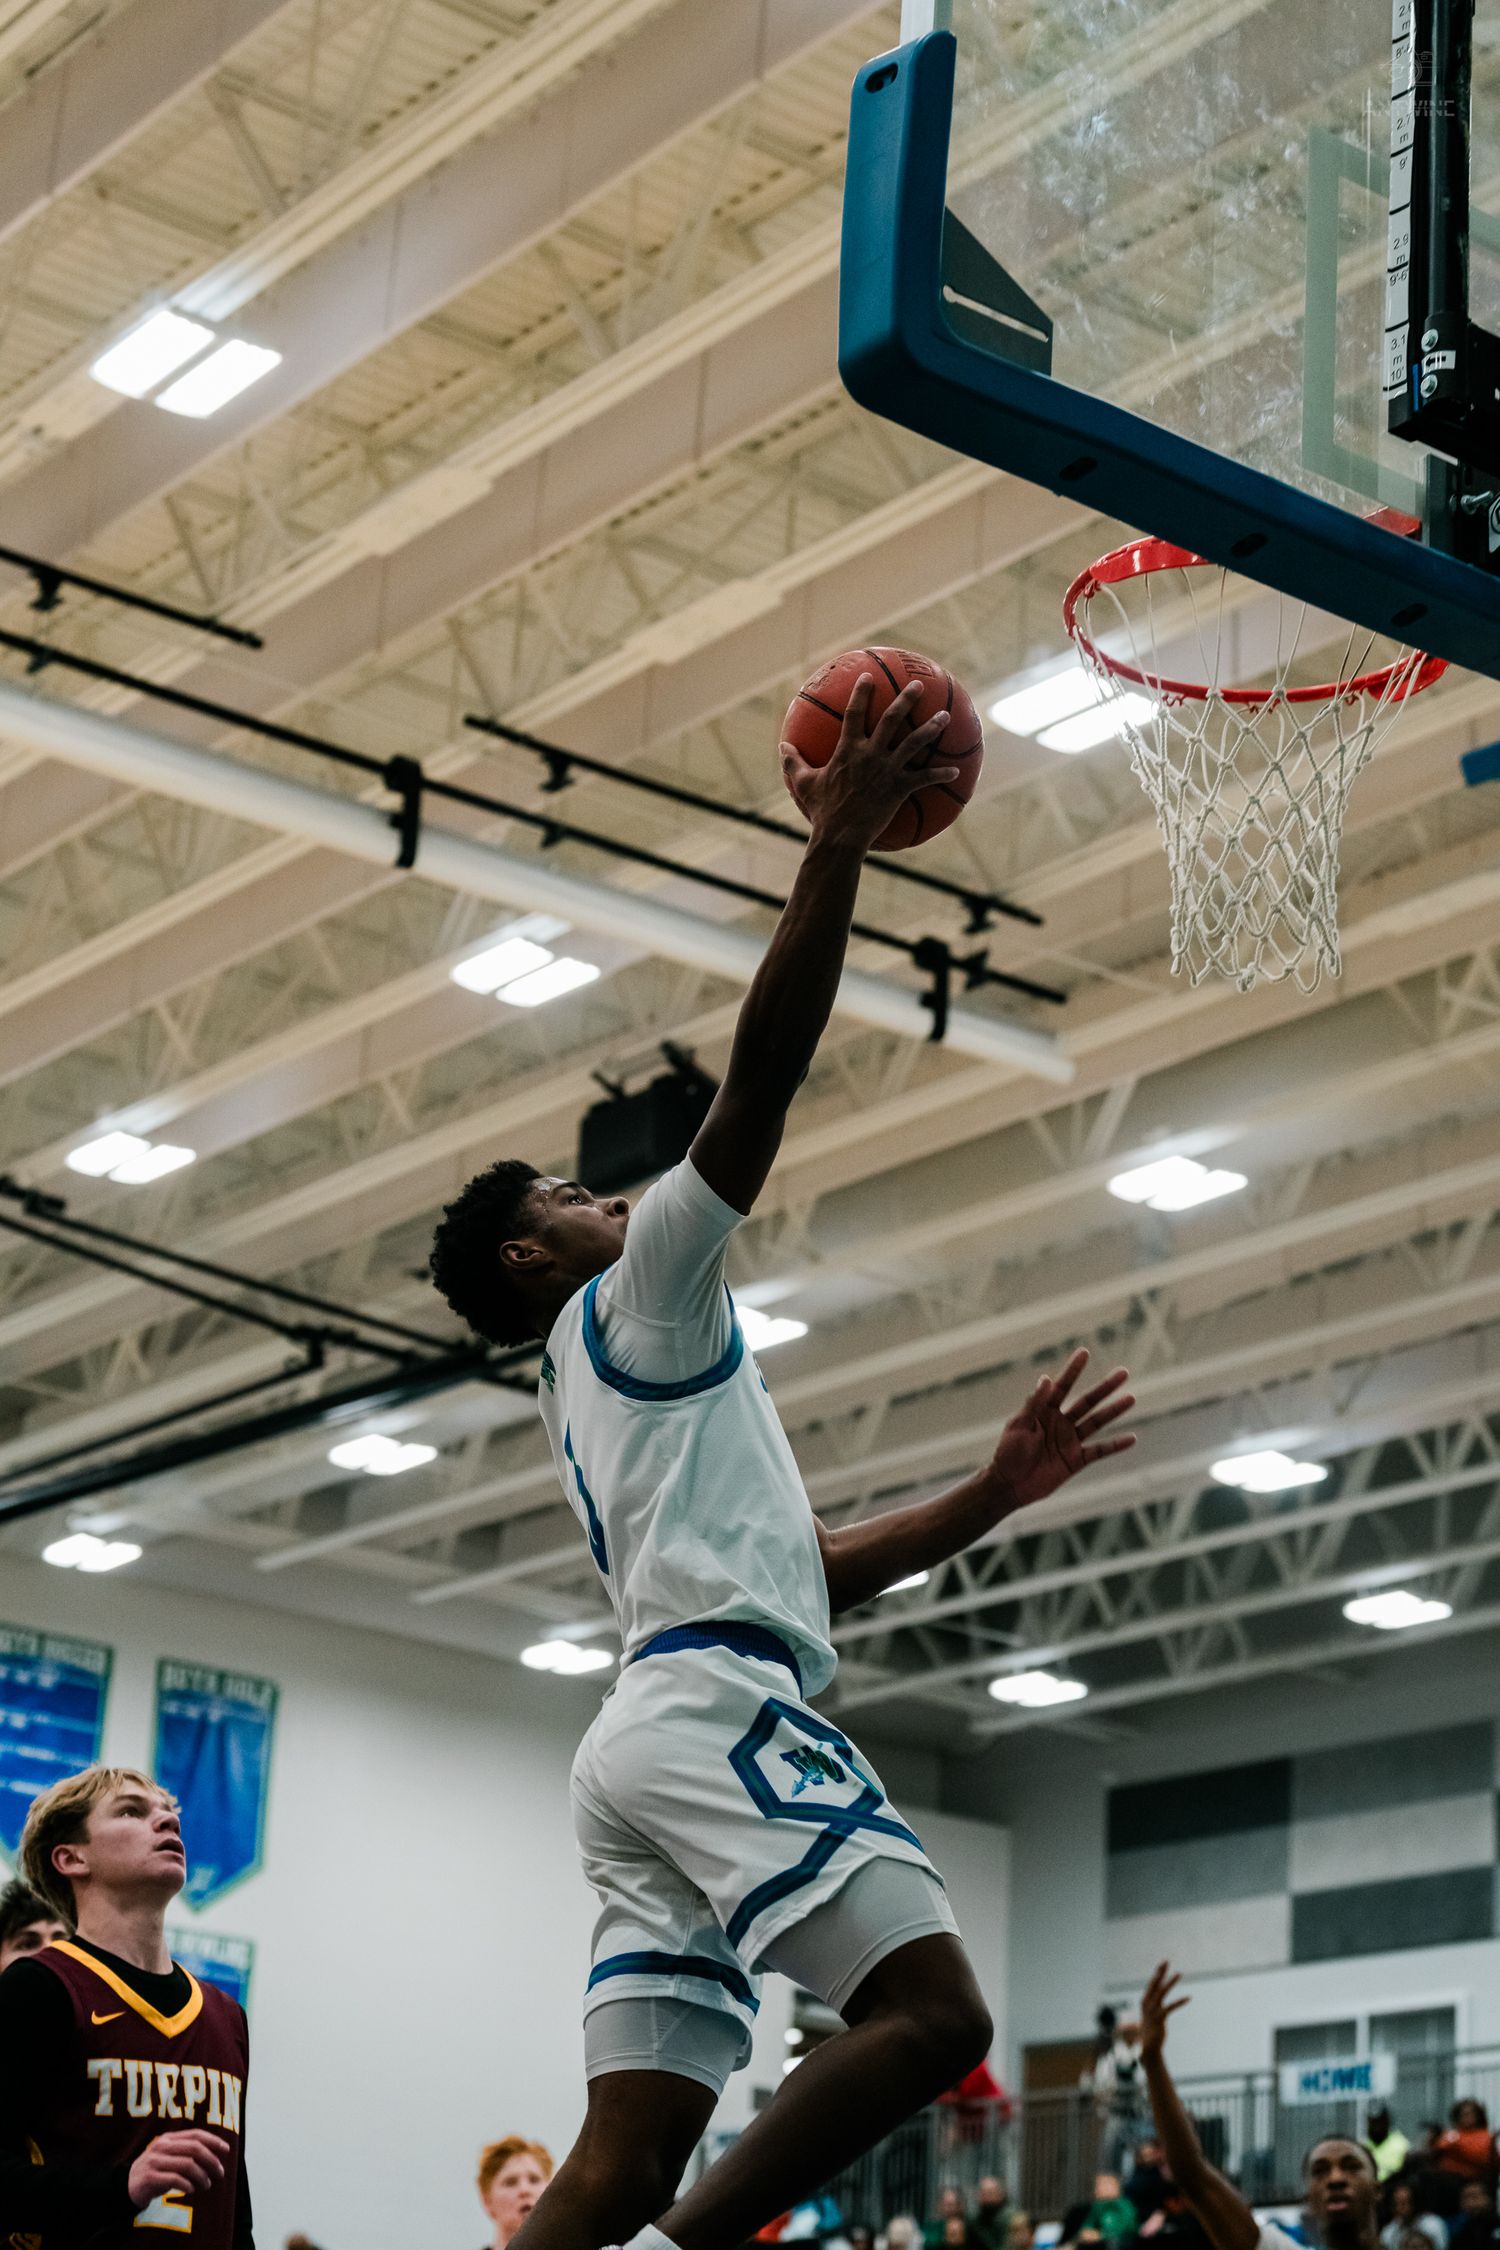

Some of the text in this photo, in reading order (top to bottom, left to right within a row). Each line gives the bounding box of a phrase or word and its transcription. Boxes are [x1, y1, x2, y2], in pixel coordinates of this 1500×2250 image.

[1396, 112, 1412, 131] 2.7
[1399, 132, 1409, 145] m
[1396, 253, 1406, 265] m
[1390, 333, 1406, 351] 3.1
[1392, 353, 1403, 367] m
[87, 2057, 242, 2136] TURPIN
